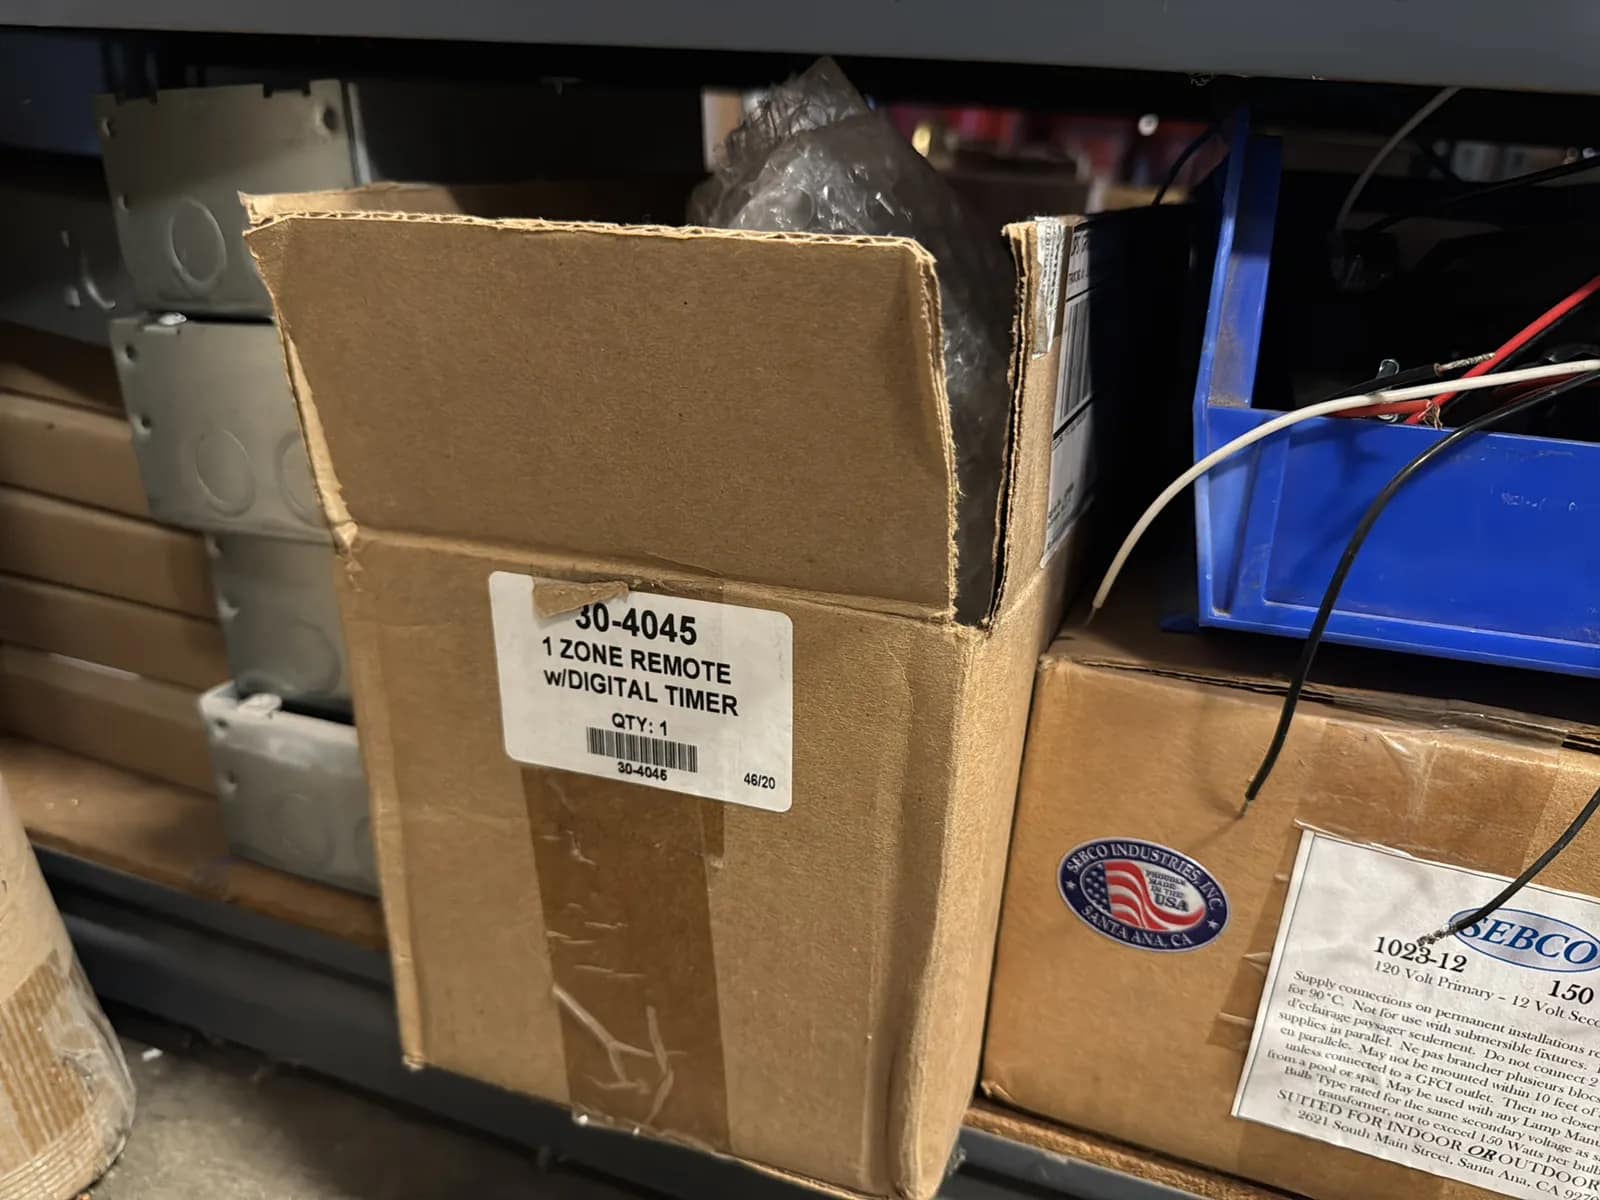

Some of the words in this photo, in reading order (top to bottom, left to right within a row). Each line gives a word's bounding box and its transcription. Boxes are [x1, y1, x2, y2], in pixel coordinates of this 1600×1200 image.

[574, 601, 698, 646] 30-4045
[542, 636, 553, 657] 1
[560, 638, 623, 668] ZONE
[631, 648, 731, 684] REMOTE
[544, 668, 659, 704] w/DIGITAL
[665, 684, 739, 717] TIMER
[611, 712, 654, 735] QTY:
[659, 720, 668, 736] 1
[617, 761, 668, 782] 30-4045
[744, 772, 776, 790] 46/20
[1066, 843, 1108, 874] SEBCO
[1111, 841, 1203, 885] INDUSTRIES,
[1149, 878, 1177, 891] MADE
[1153, 891, 1190, 913] USA
[1164, 887, 1185, 899] THE
[1081, 904, 1129, 940] SANTA
[1130, 931, 1169, 949] ANA,
[1170, 931, 1194, 947] CA
[1459, 917, 1598, 966] SEBCO
[1375, 937, 1467, 972] 1023-12
[1294, 971, 1336, 990] Supply
[1338, 985, 1411, 1008] connections
[1415, 1004, 1431, 1013] on
[1435, 1009, 1504, 1033] permanent
[1508, 1025, 1584, 1053] installations
[1375, 960, 1400, 975] 120
[1406, 968, 1432, 984] Volt
[1437, 976, 1494, 1000] Primary
[1512, 995, 1529, 1008] 12
[1536, 1000, 1564, 1017] Volt
[1548, 980, 1594, 1004] 150
[1288, 983, 1306, 995] for
[1352, 999, 1376, 1014] Not
[1379, 1008, 1398, 1019] for
[1401, 1015, 1422, 1025] use
[1426, 1021, 1451, 1033] with
[1454, 1029, 1532, 1055] submersible
[1535, 1048, 1586, 1069] fixtures.
[1279, 1012, 1326, 1031] supplies
[1330, 1023, 1341, 1034] in
[1344, 1029, 1392, 1047] parallel.
[1400, 1041, 1419, 1054] Ne
[1421, 1049, 1443, 1060] pas
[1447, 1053, 1504, 1076] brancher
[1505, 1071, 1564, 1093] plusieurs
[1280, 1027, 1294, 1036] en
[1359, 1044, 1386, 1060] May
[1389, 1055, 1409, 1065] not
[1412, 1058, 1428, 1070] be
[1431, 1066, 1488, 1087] mounted
[1492, 1082, 1529, 1098] within
[1535, 1092, 1550, 1103] 10
[1553, 1097, 1577, 1112] feet
[1581, 1107, 1595, 1116] of
[1352, 1017, 1405, 1036] paysager
[1409, 1032, 1475, 1054] seulement.
[1484, 1049, 1504, 1061] Do
[1508, 1058, 1529, 1069] not
[1533, 1065, 1585, 1084] connect
[1588, 1077, 1598, 1087] 2
[1267, 1049, 1295, 1063] from
[1308, 1062, 1336, 1075] pool
[1356, 1074, 1379, 1085] spa.
[1386, 1080, 1413, 1095] May
[1416, 1088, 1431, 1099] be
[1435, 1095, 1464, 1108] used
[1468, 1104, 1493, 1116] with
[1496, 1113, 1519, 1124] any
[1522, 1117, 1560, 1136] Lamp
[1285, 1043, 1321, 1056] unless
[1325, 1053, 1387, 1073] connected
[1389, 1068, 1401, 1077] to
[1415, 1074, 1452, 1091] GFCI
[1455, 1088, 1493, 1103] outlet.
[1503, 1097, 1536, 1114] Then
[1540, 1110, 1557, 1120] no
[1561, 1115, 1600, 1131] closer
[1284, 1066, 1312, 1079] Bulb
[1316, 1073, 1346, 1089] Type
[1349, 1085, 1381, 1099] rated
[1383, 1093, 1401, 1104] for
[1404, 1099, 1423, 1111] the
[1426, 1107, 1458, 1121] same
[1462, 1117, 1525, 1140] secondary
[1528, 1135, 1572, 1153] voltage
[1575, 1150, 1589, 1158] as
[1298, 1110, 1327, 1126] 2621
[1332, 1121, 1369, 1138] South
[1374, 1132, 1407, 1150] Main
[1457, 1158, 1493, 1175] Santa
[1498, 1170, 1530, 1187] Ana,
[1536, 1181, 1558, 1195] CA
[1347, 1109, 1382, 1128] FOR
[1387, 1121, 1462, 1151] INDOOR
[1466, 1145, 1497, 1160] OR
[1498, 1154, 1599, 1190] OUTDOOR
[1394, 1111, 1414, 1122] not
[1417, 1117, 1430, 1126] to
[1433, 1123, 1476, 1139] exceed
[1480, 1133, 1503, 1146] 150
[1508, 1141, 1543, 1158] Watts
[1546, 1155, 1569, 1165] per
